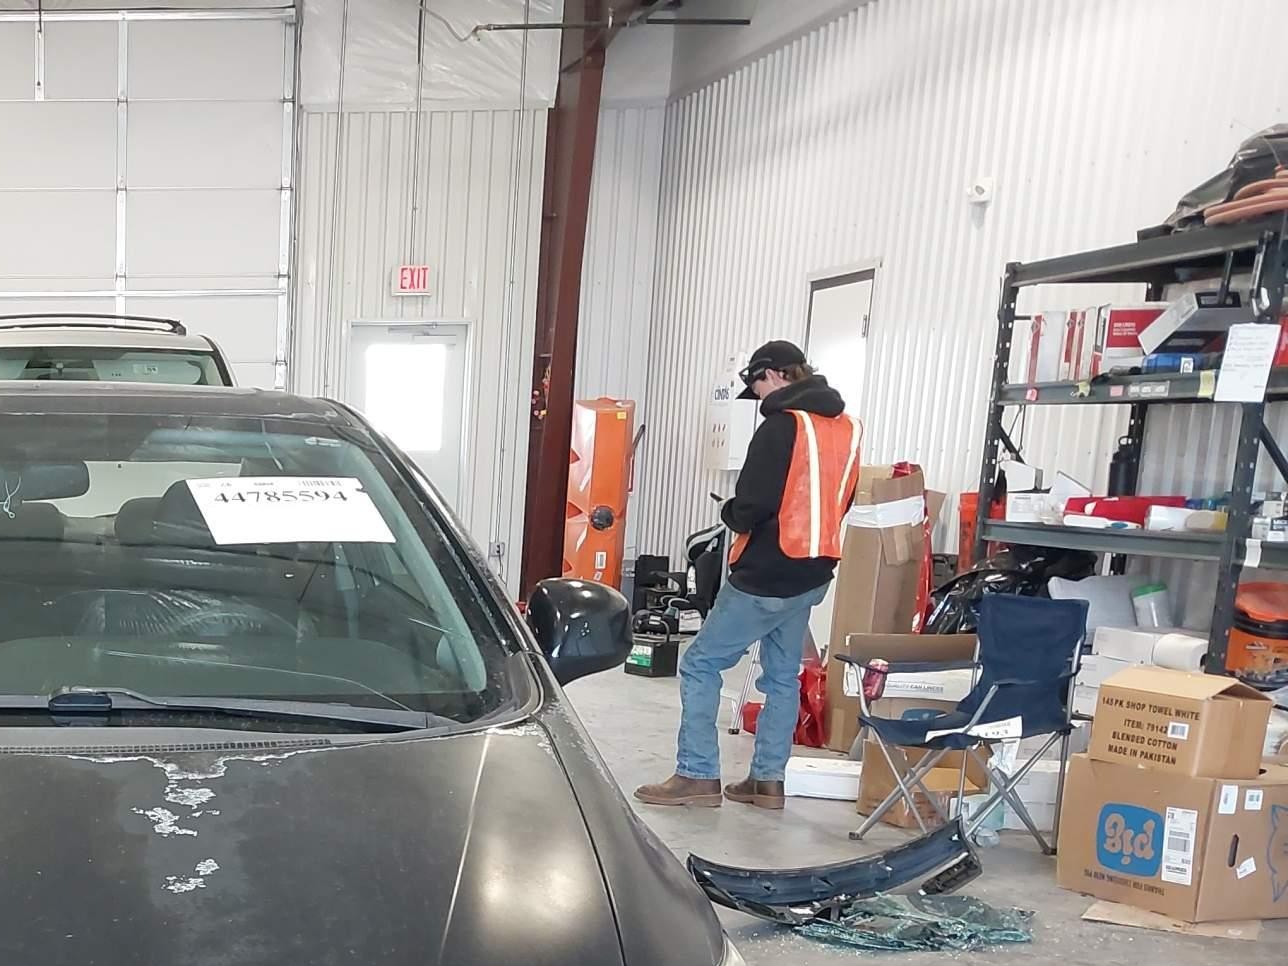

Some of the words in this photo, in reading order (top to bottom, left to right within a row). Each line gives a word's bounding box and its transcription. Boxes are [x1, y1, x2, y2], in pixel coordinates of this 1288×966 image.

[400, 267, 429, 289] EXIT
[214, 490, 347, 503] 44785594
[1126, 700, 1146, 711] SHOP
[1148, 704, 1173, 717] TOWEL
[1174, 708, 1201, 721] WHITE
[1111, 731, 1145, 744] BLENDED
[1147, 738, 1178, 750] COTTON
[1107, 744, 1127, 756] MADE
[1129, 748, 1138, 758] IN
[1139, 750, 1177, 765] PAKISTAN
